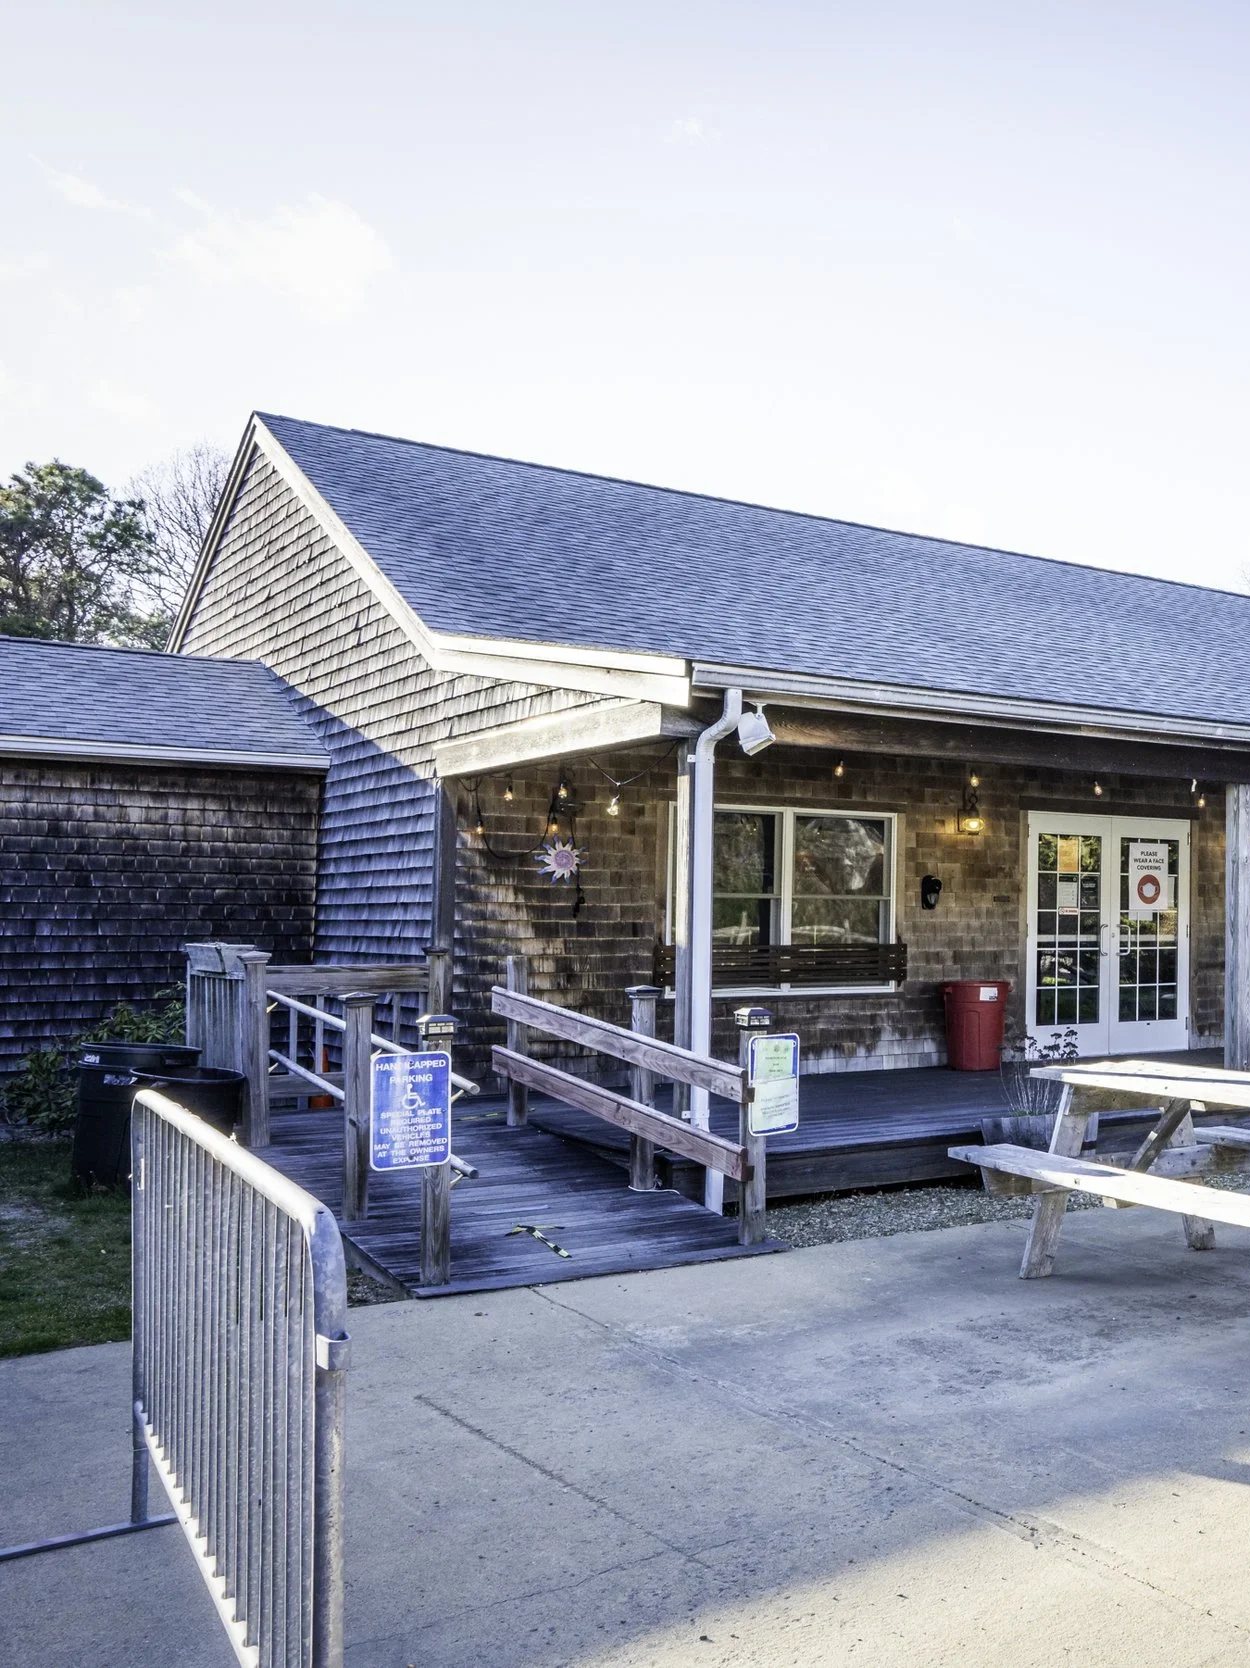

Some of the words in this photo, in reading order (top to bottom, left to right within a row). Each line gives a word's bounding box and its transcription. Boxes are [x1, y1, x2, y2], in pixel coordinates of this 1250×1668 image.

[376, 1060, 446, 1072] HANICAPPED
[389, 1073, 433, 1084] PARKING
[380, 1110, 415, 1119] SPECIAL
[391, 1116, 432, 1126] REQUIRED
[380, 1123, 443, 1135] UNAUTHORIZED
[391, 1131, 432, 1141] VEHICLES
[374, 1143, 391, 1151] MAY
[394, 1141, 406, 1149] BE
[408, 1137, 448, 1147] REMOVED
[409, 1145, 445, 1155] OWNERS
